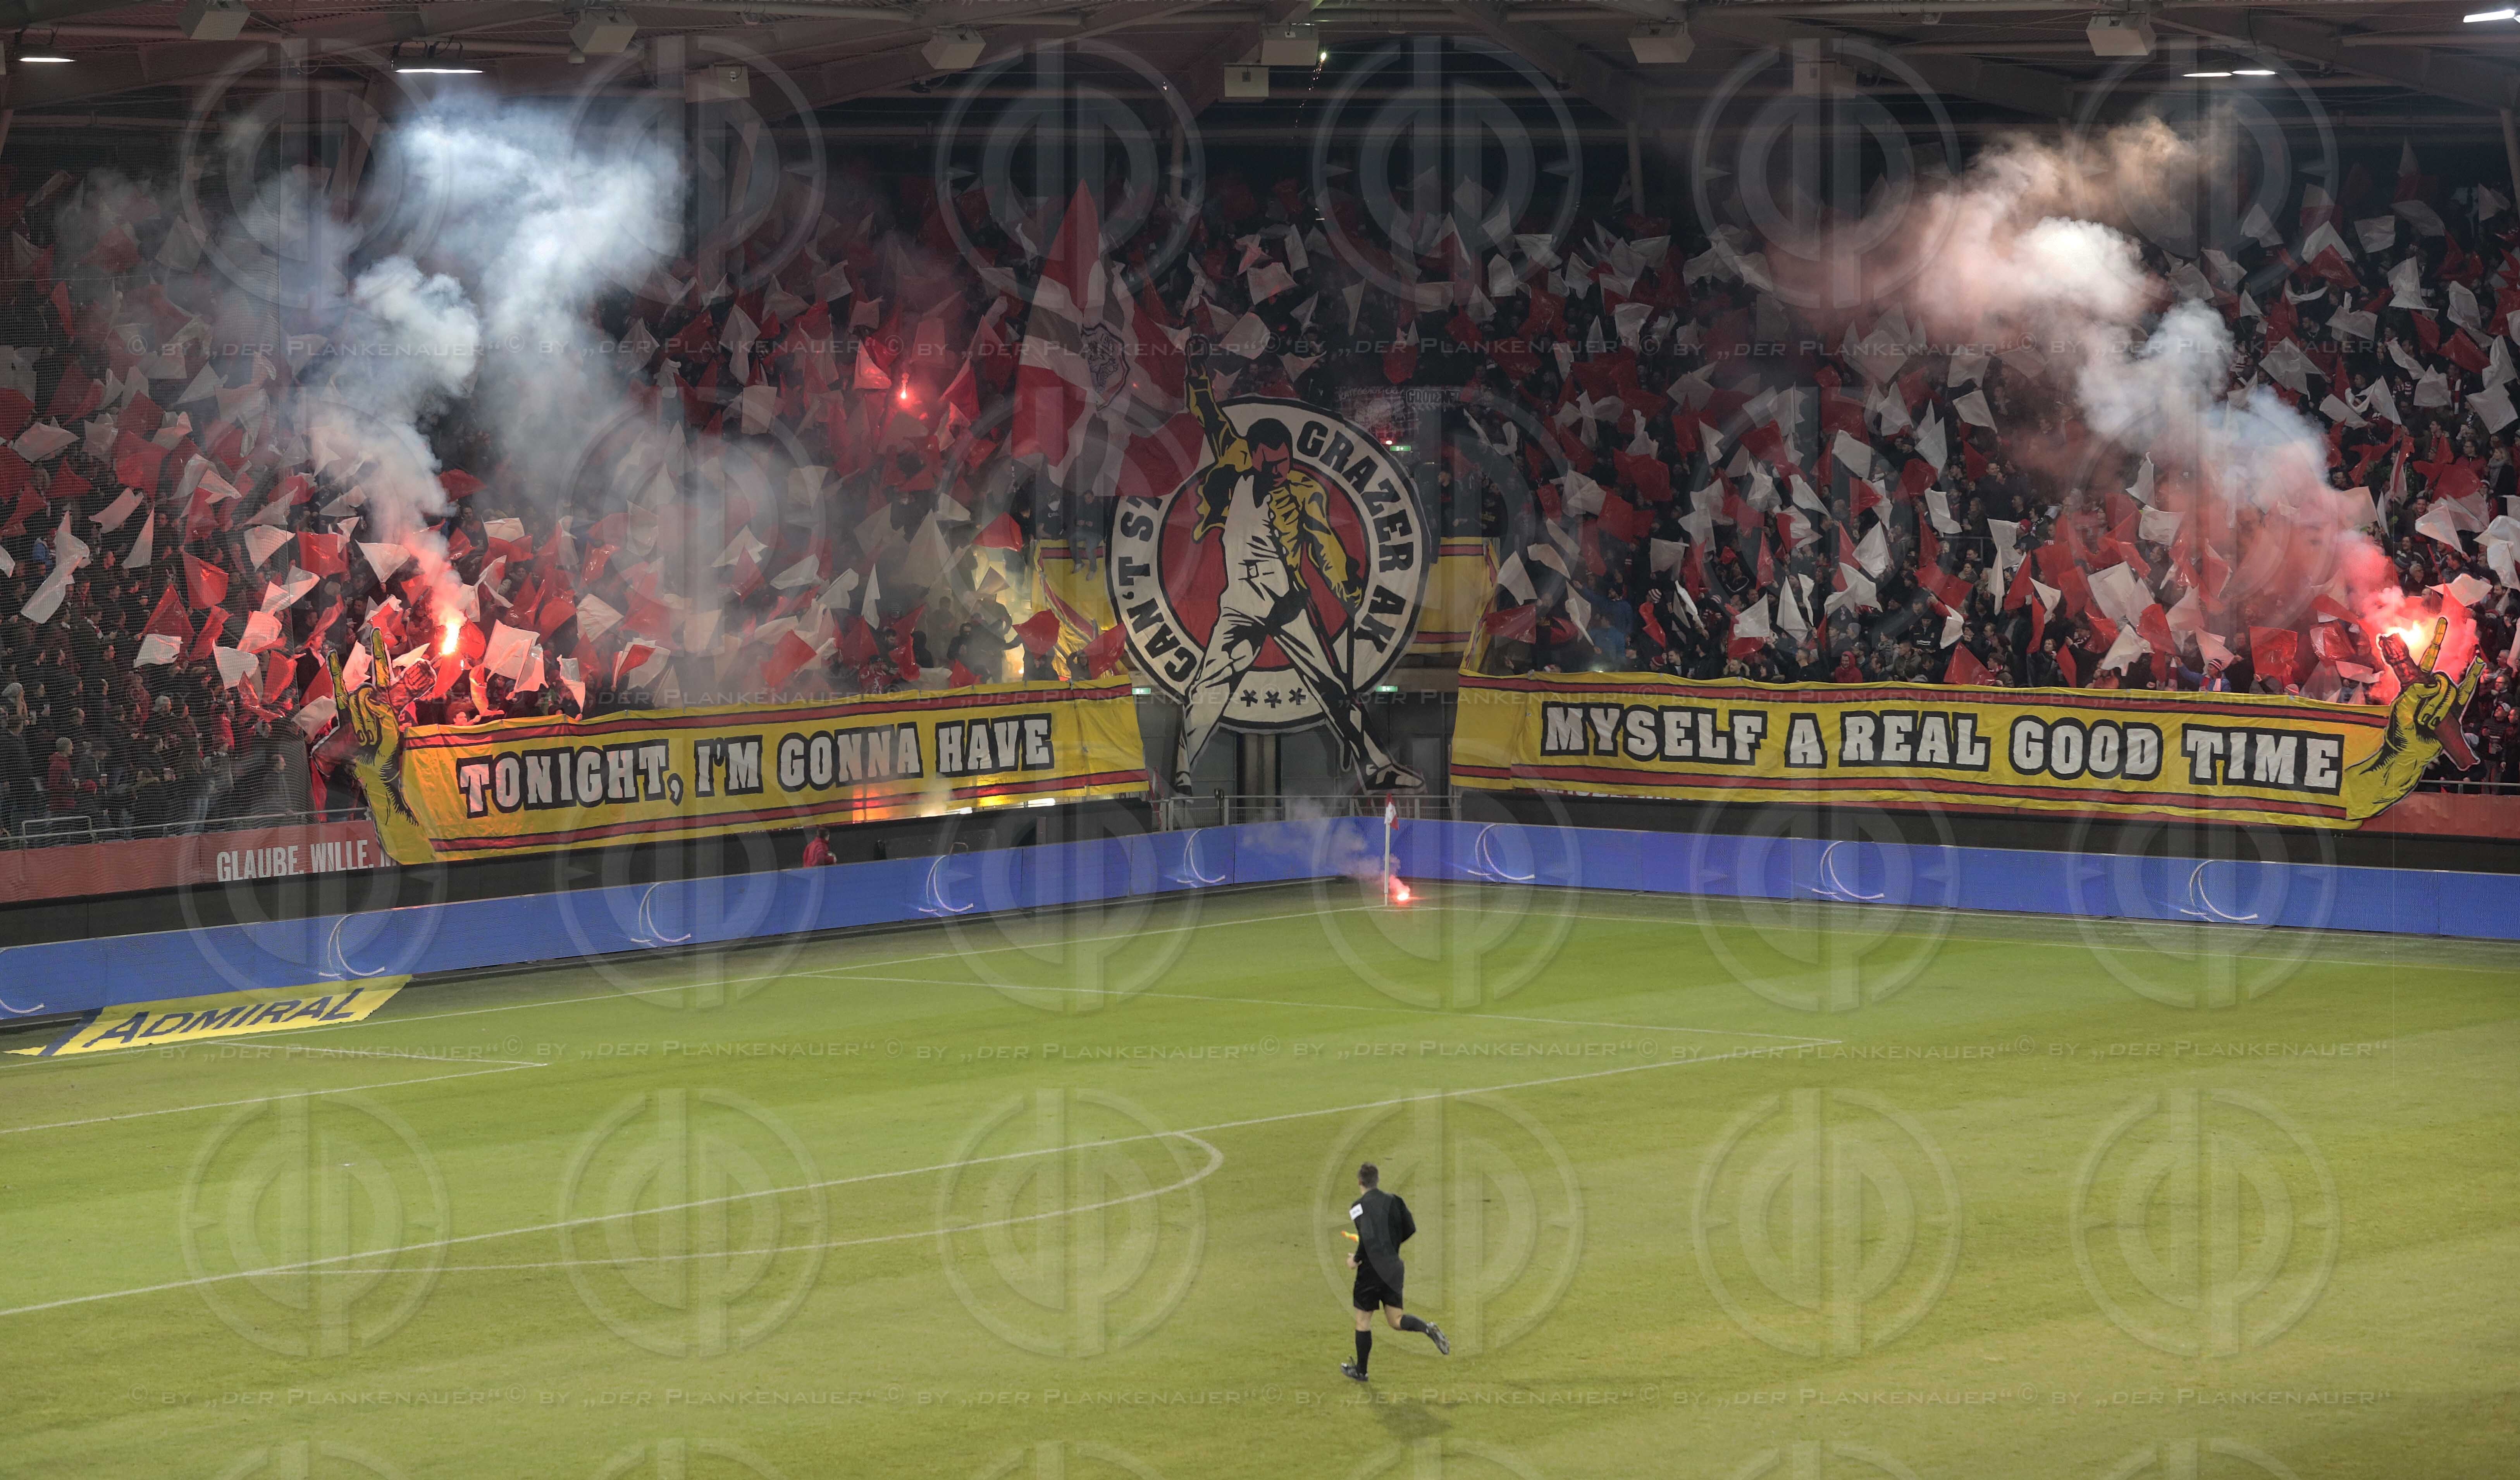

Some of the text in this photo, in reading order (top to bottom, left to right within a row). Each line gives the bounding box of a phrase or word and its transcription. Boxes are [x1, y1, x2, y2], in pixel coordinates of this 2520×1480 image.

[1297, 421, 1414, 573] GRAZER
[1118, 556, 1197, 682] CAN'T
[1354, 585, 1406, 654] AK
[459, 716, 1052, 816] TONIGHT, I'M GONNA HAVE
[1543, 705, 2342, 792] MYSELF A REAL GOOD TIME
[217, 845, 304, 882] GLAUBE.
[310, 840, 374, 873] WILLE.
[82, 988, 363, 1048] ADMIRAL
